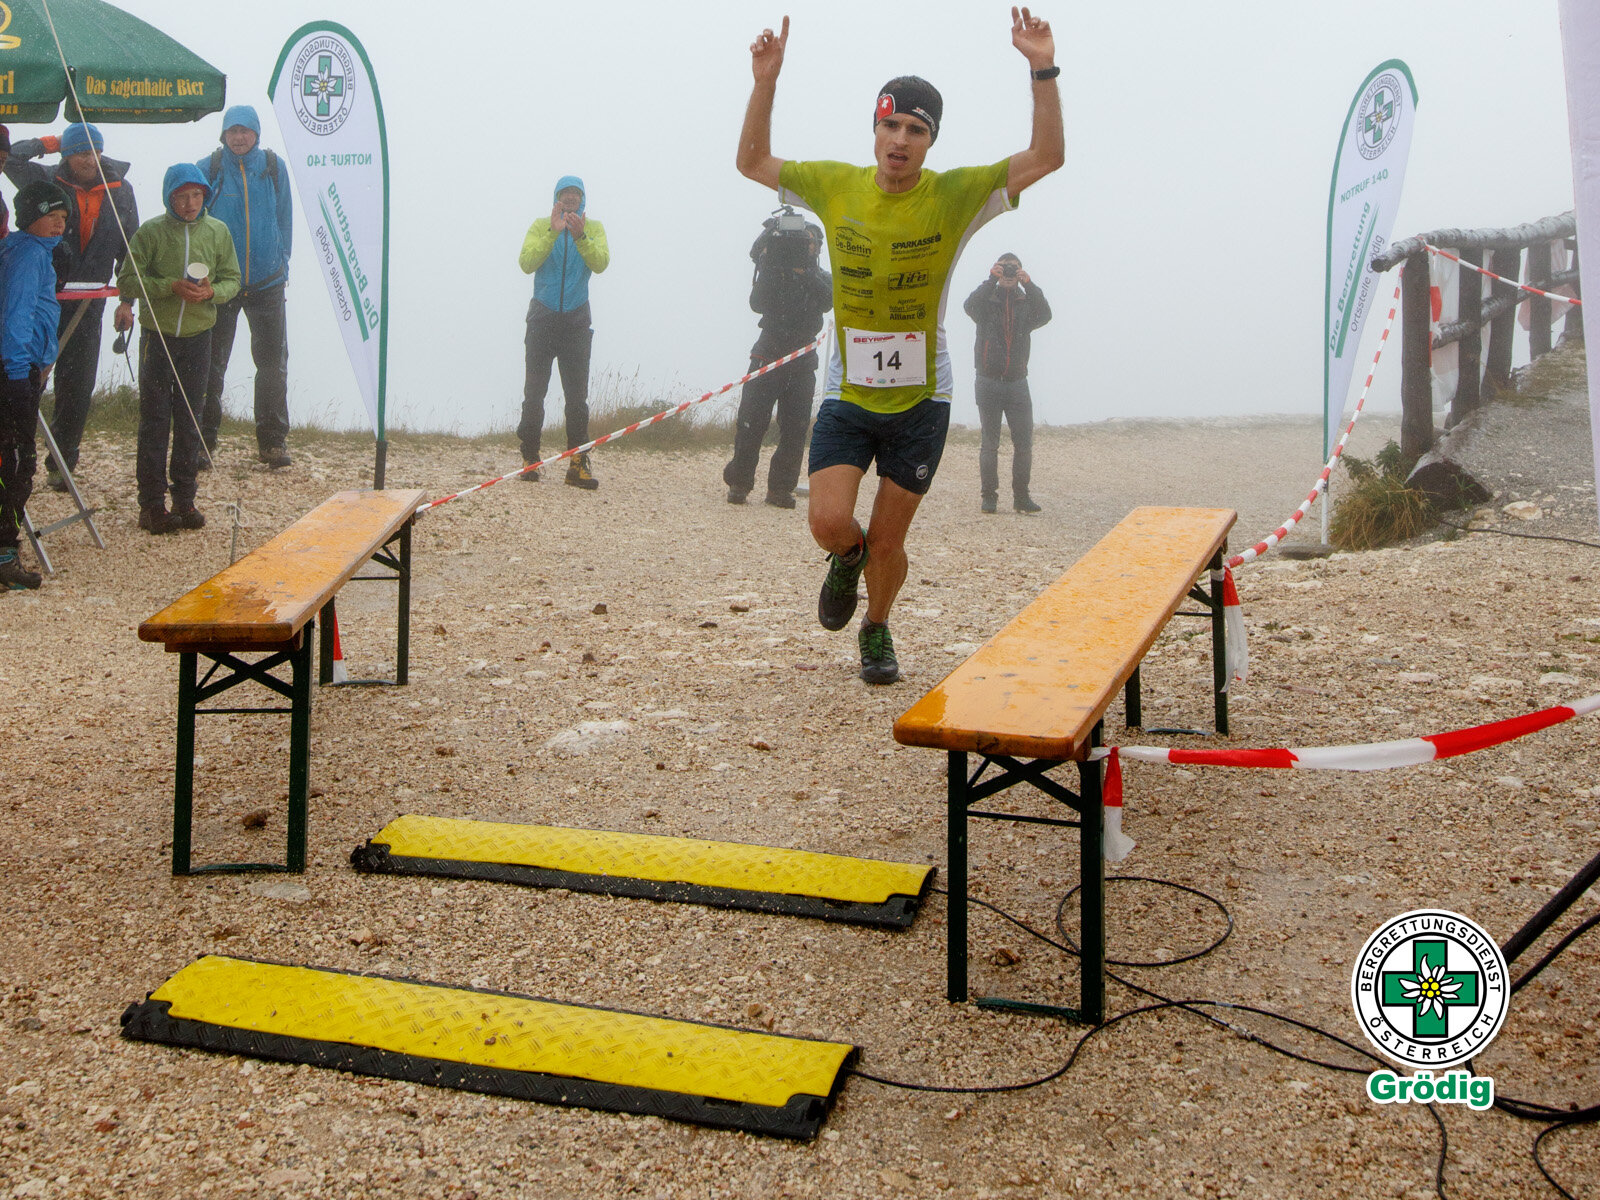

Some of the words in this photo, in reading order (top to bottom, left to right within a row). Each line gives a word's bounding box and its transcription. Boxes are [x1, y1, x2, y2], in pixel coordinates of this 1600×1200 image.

[86, 75, 107, 95] Das
[177, 78, 205, 97] Bier
[1340, 177, 1370, 204] NOTRUF
[1371, 168, 1389, 185] 140
[891, 235, 936, 250] SPARKASSE
[1329, 319, 1341, 352] Die
[1337, 201, 1371, 314] Bergrettung
[1350, 276, 1372, 333] Ortsstelle
[889, 312, 916, 321] Allianz
[873, 350, 902, 371] 14
